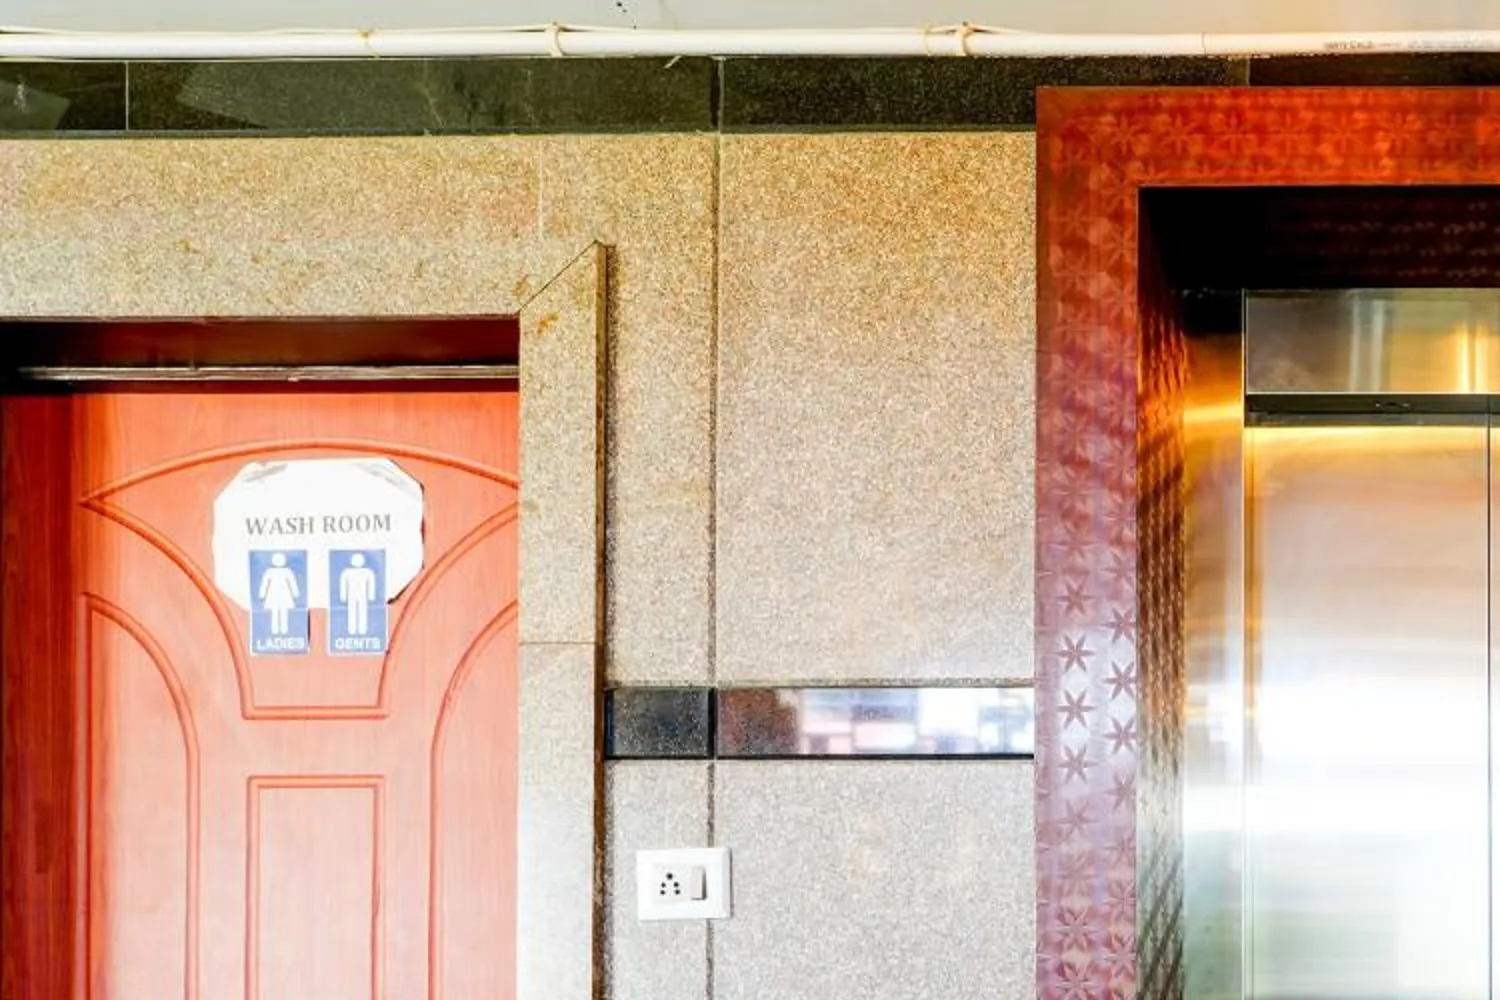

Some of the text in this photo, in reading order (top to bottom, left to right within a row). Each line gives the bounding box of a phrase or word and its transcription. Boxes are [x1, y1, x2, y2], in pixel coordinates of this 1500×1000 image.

[245, 513, 391, 535] WASH ROOM
[256, 637, 305, 650] LADIES
[335, 637, 381, 650] GENTS
